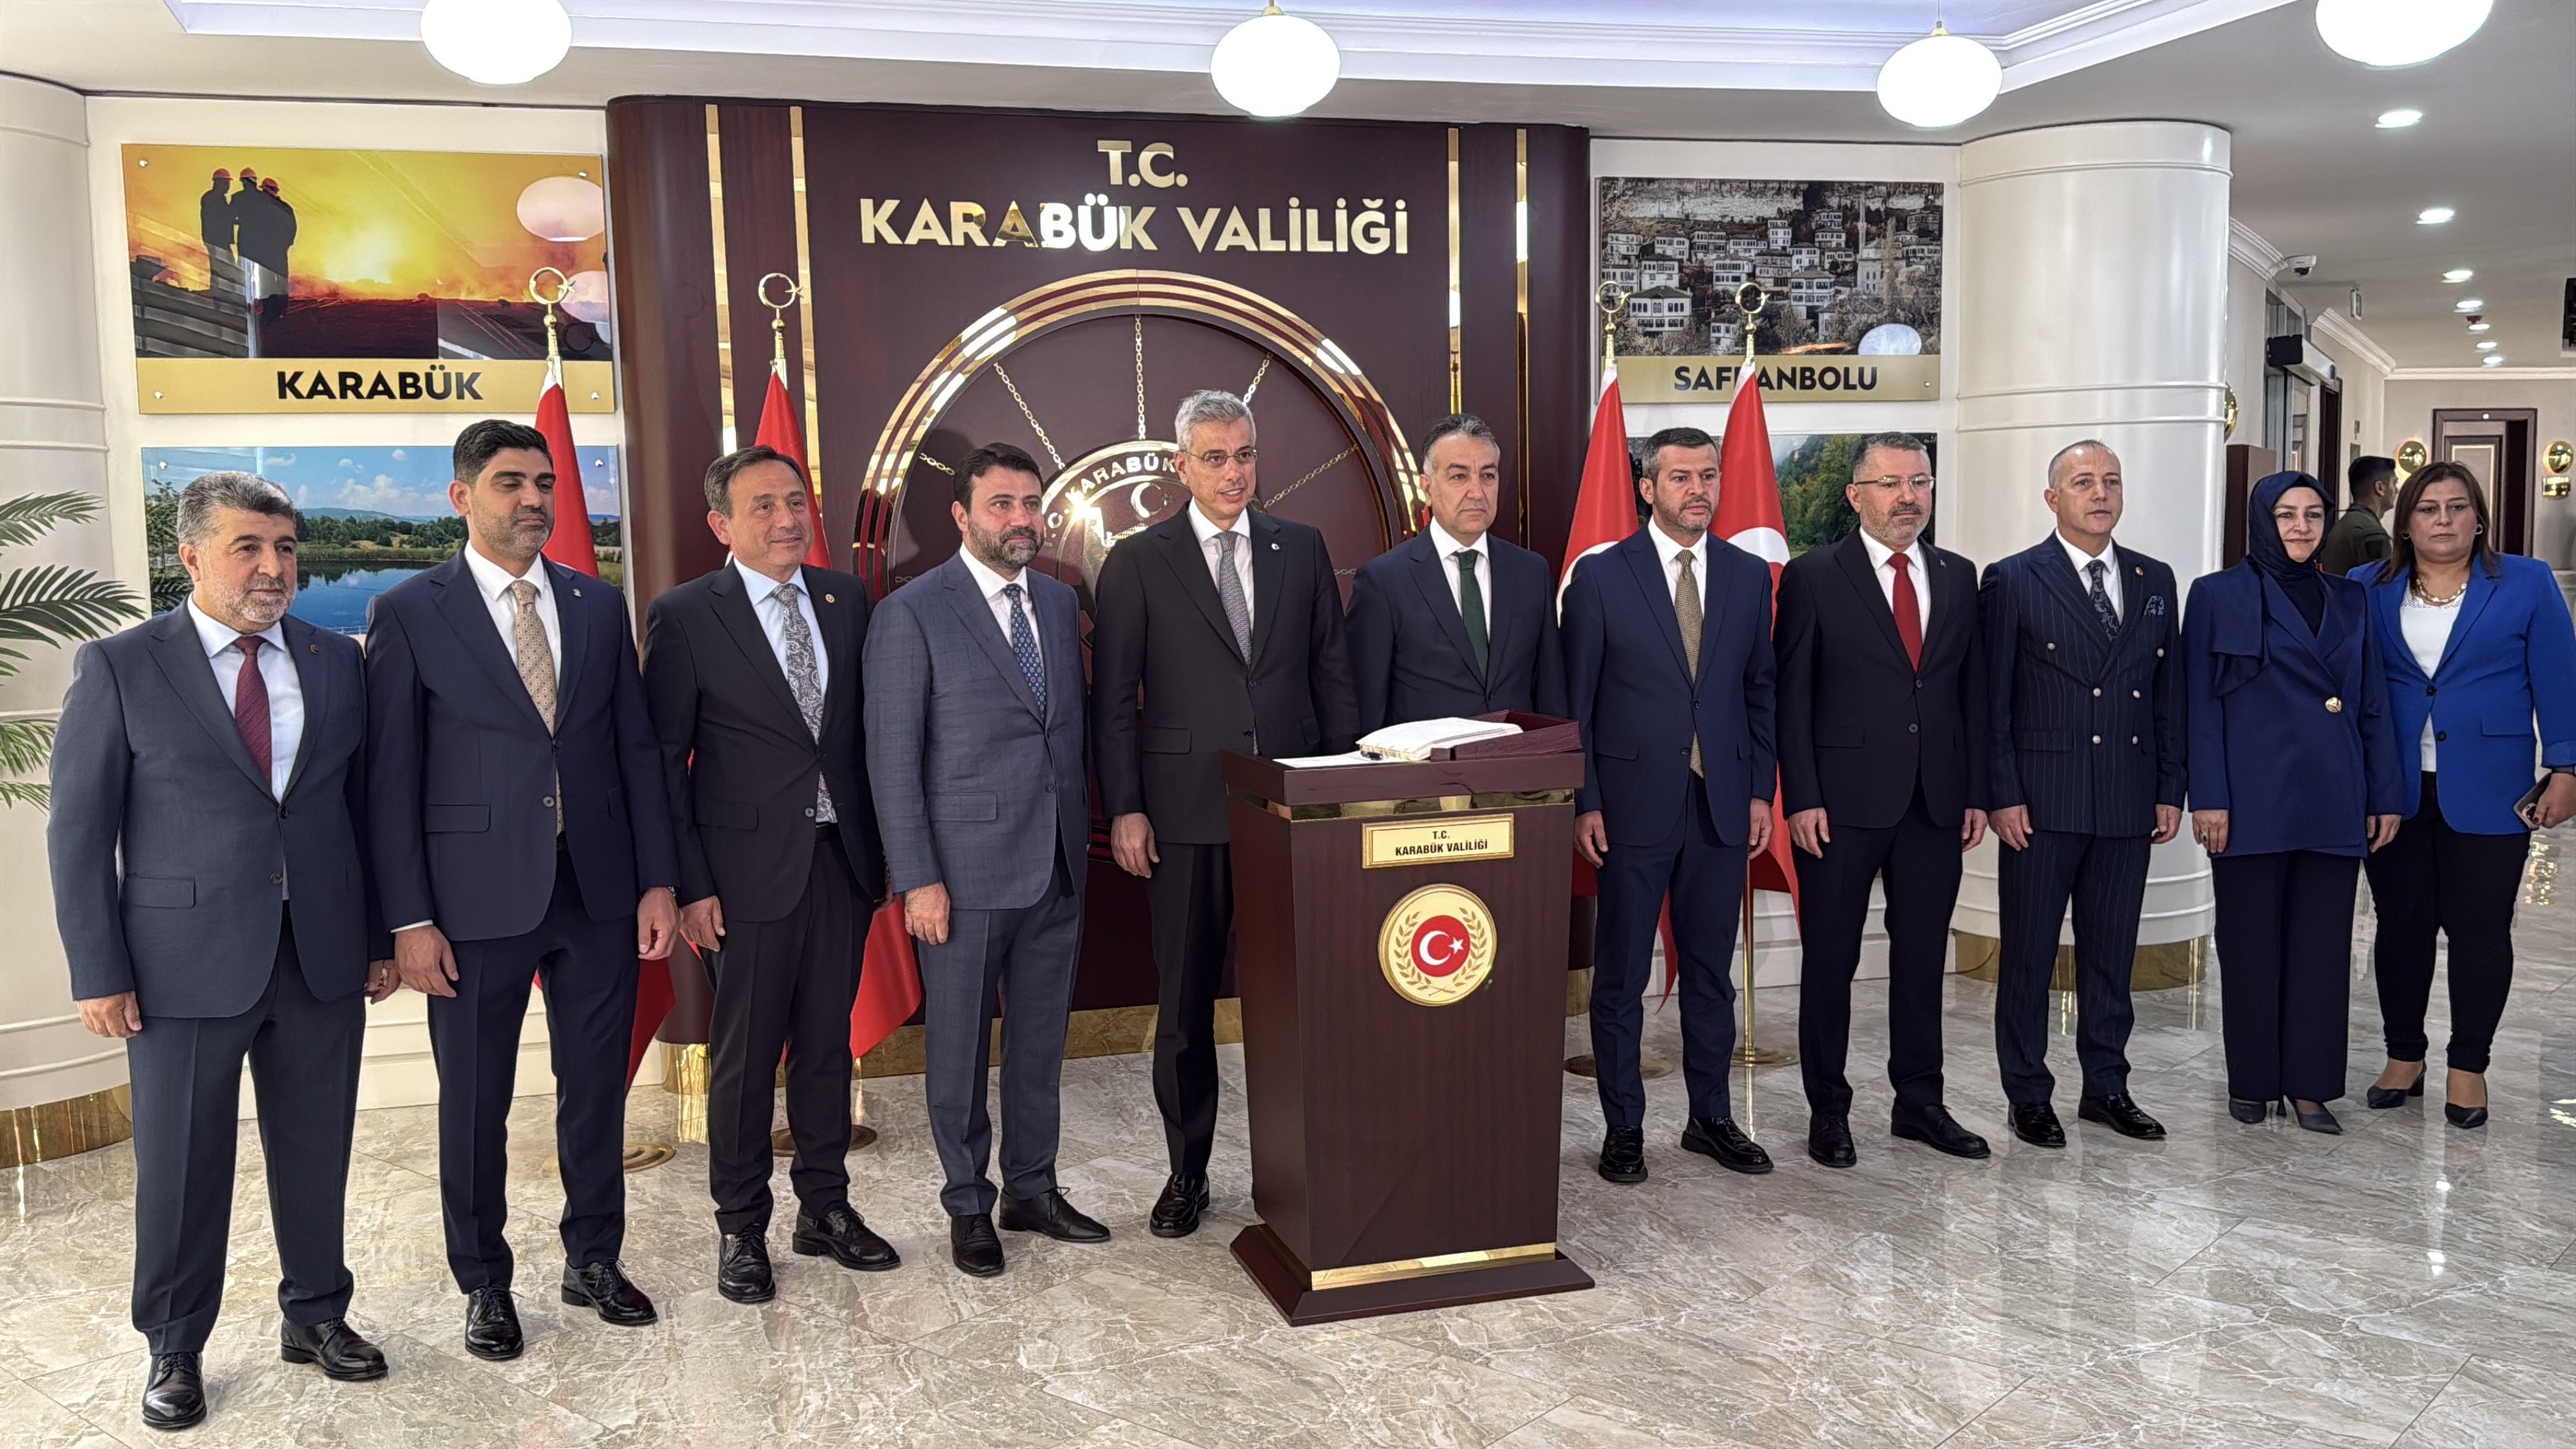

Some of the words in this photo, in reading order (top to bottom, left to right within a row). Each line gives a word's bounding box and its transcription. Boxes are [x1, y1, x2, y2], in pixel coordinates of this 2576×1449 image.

[1098, 140, 1188, 188] T.C.
[860, 193, 1158, 252] KARABÜK
[1176, 197, 1408, 255] VALİLİĞİ
[277, 364, 484, 400] KARABÜK
[1674, 365, 1878, 391] SAFANBOLU
[1395, 842, 1444, 856] KARABÜK
[1447, 838, 1488, 853] VALİLİĞİ
[1432, 830, 1450, 840] T.C.
